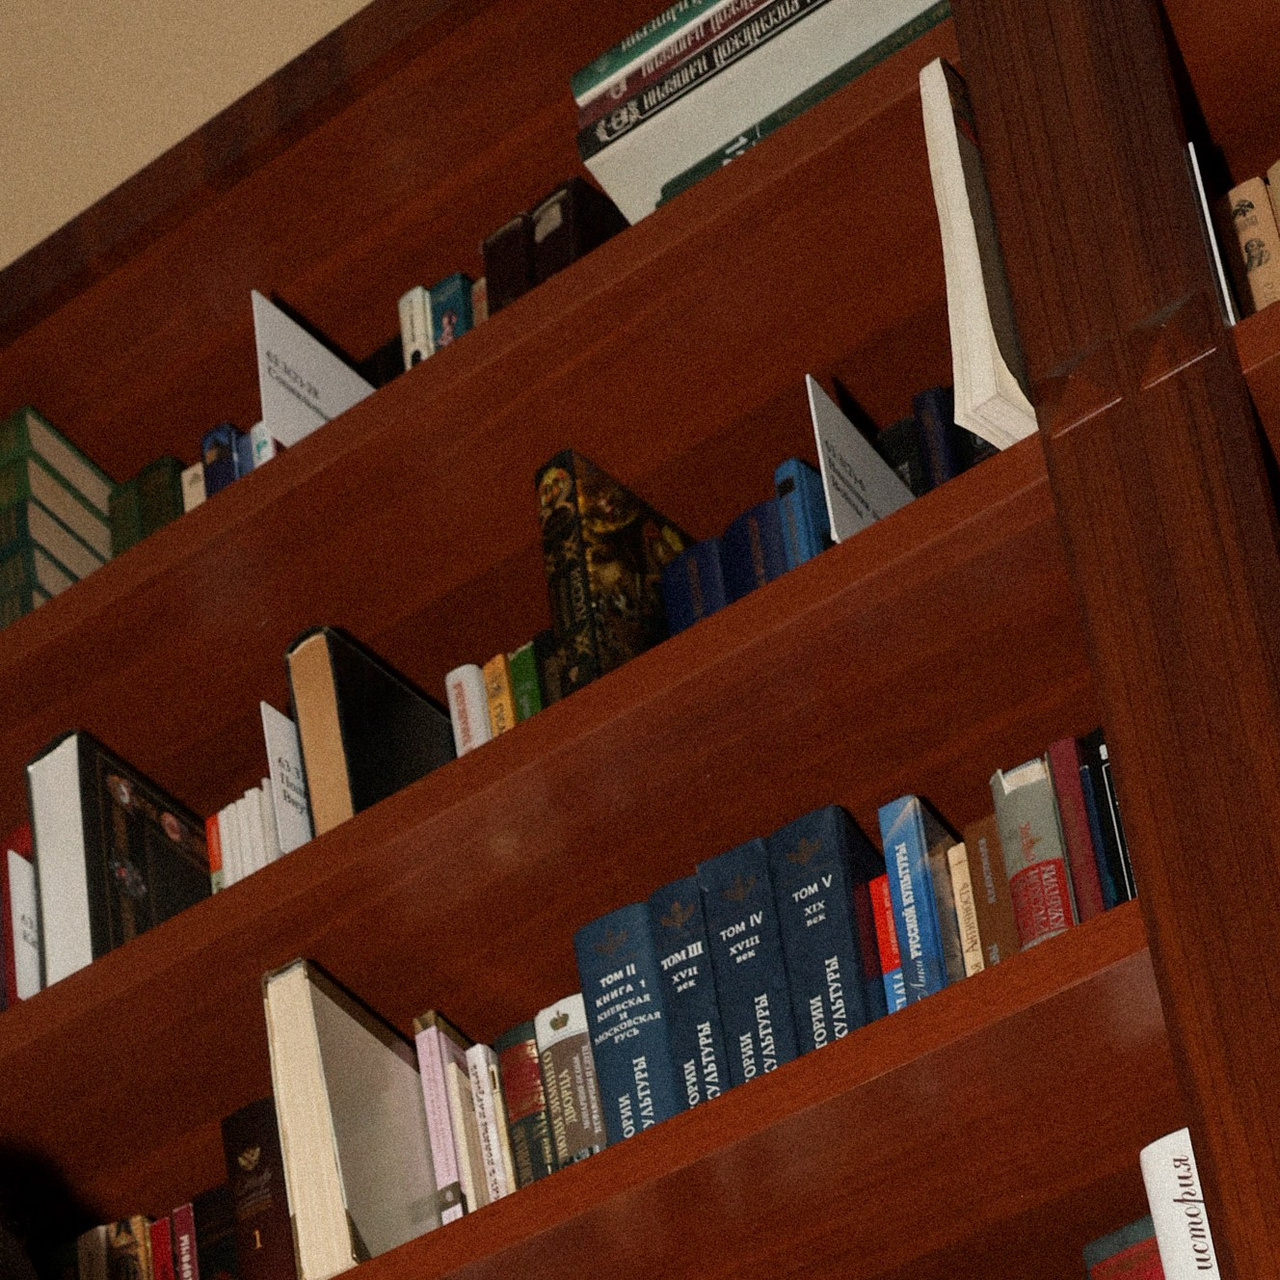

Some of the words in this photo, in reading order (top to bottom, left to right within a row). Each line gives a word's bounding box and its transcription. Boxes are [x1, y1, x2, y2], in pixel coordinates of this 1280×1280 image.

[792, 883, 819, 903] ТОМ
[821, 874, 833, 888] V
[895, 842, 914, 906] КУЛЬТУРЫ
[803, 900, 826, 917] XIX
[806, 912, 827, 928] век
[720, 923, 746, 942] ТОМ
[749, 911, 764, 927] IV
[902, 905, 922, 959] РУССКОЙ
[661, 950, 687, 971] ТОМ
[686, 941, 704, 959] III
[729, 934, 760, 957] XVIII
[735, 949, 756, 964] век
[599, 969, 624, 988] ТОМ
[626, 963, 636, 976] II
[671, 966, 699, 985] XVII
[677, 980, 697, 993] век
[595, 984, 634, 1008] КНИГА
[639, 979, 646, 989] 1
[596, 993, 651, 1023] КИЕВСКАЯ
[595, 1011, 661, 1046] МОСКОВСКАЯ
[614, 1028, 639, 1044] РУСЬ
[539, 1050, 561, 1115] ЗИМНЕГО
[559, 1069, 577, 1124] ДВОРЦА
[1163, 1152, 1218, 1275] история
